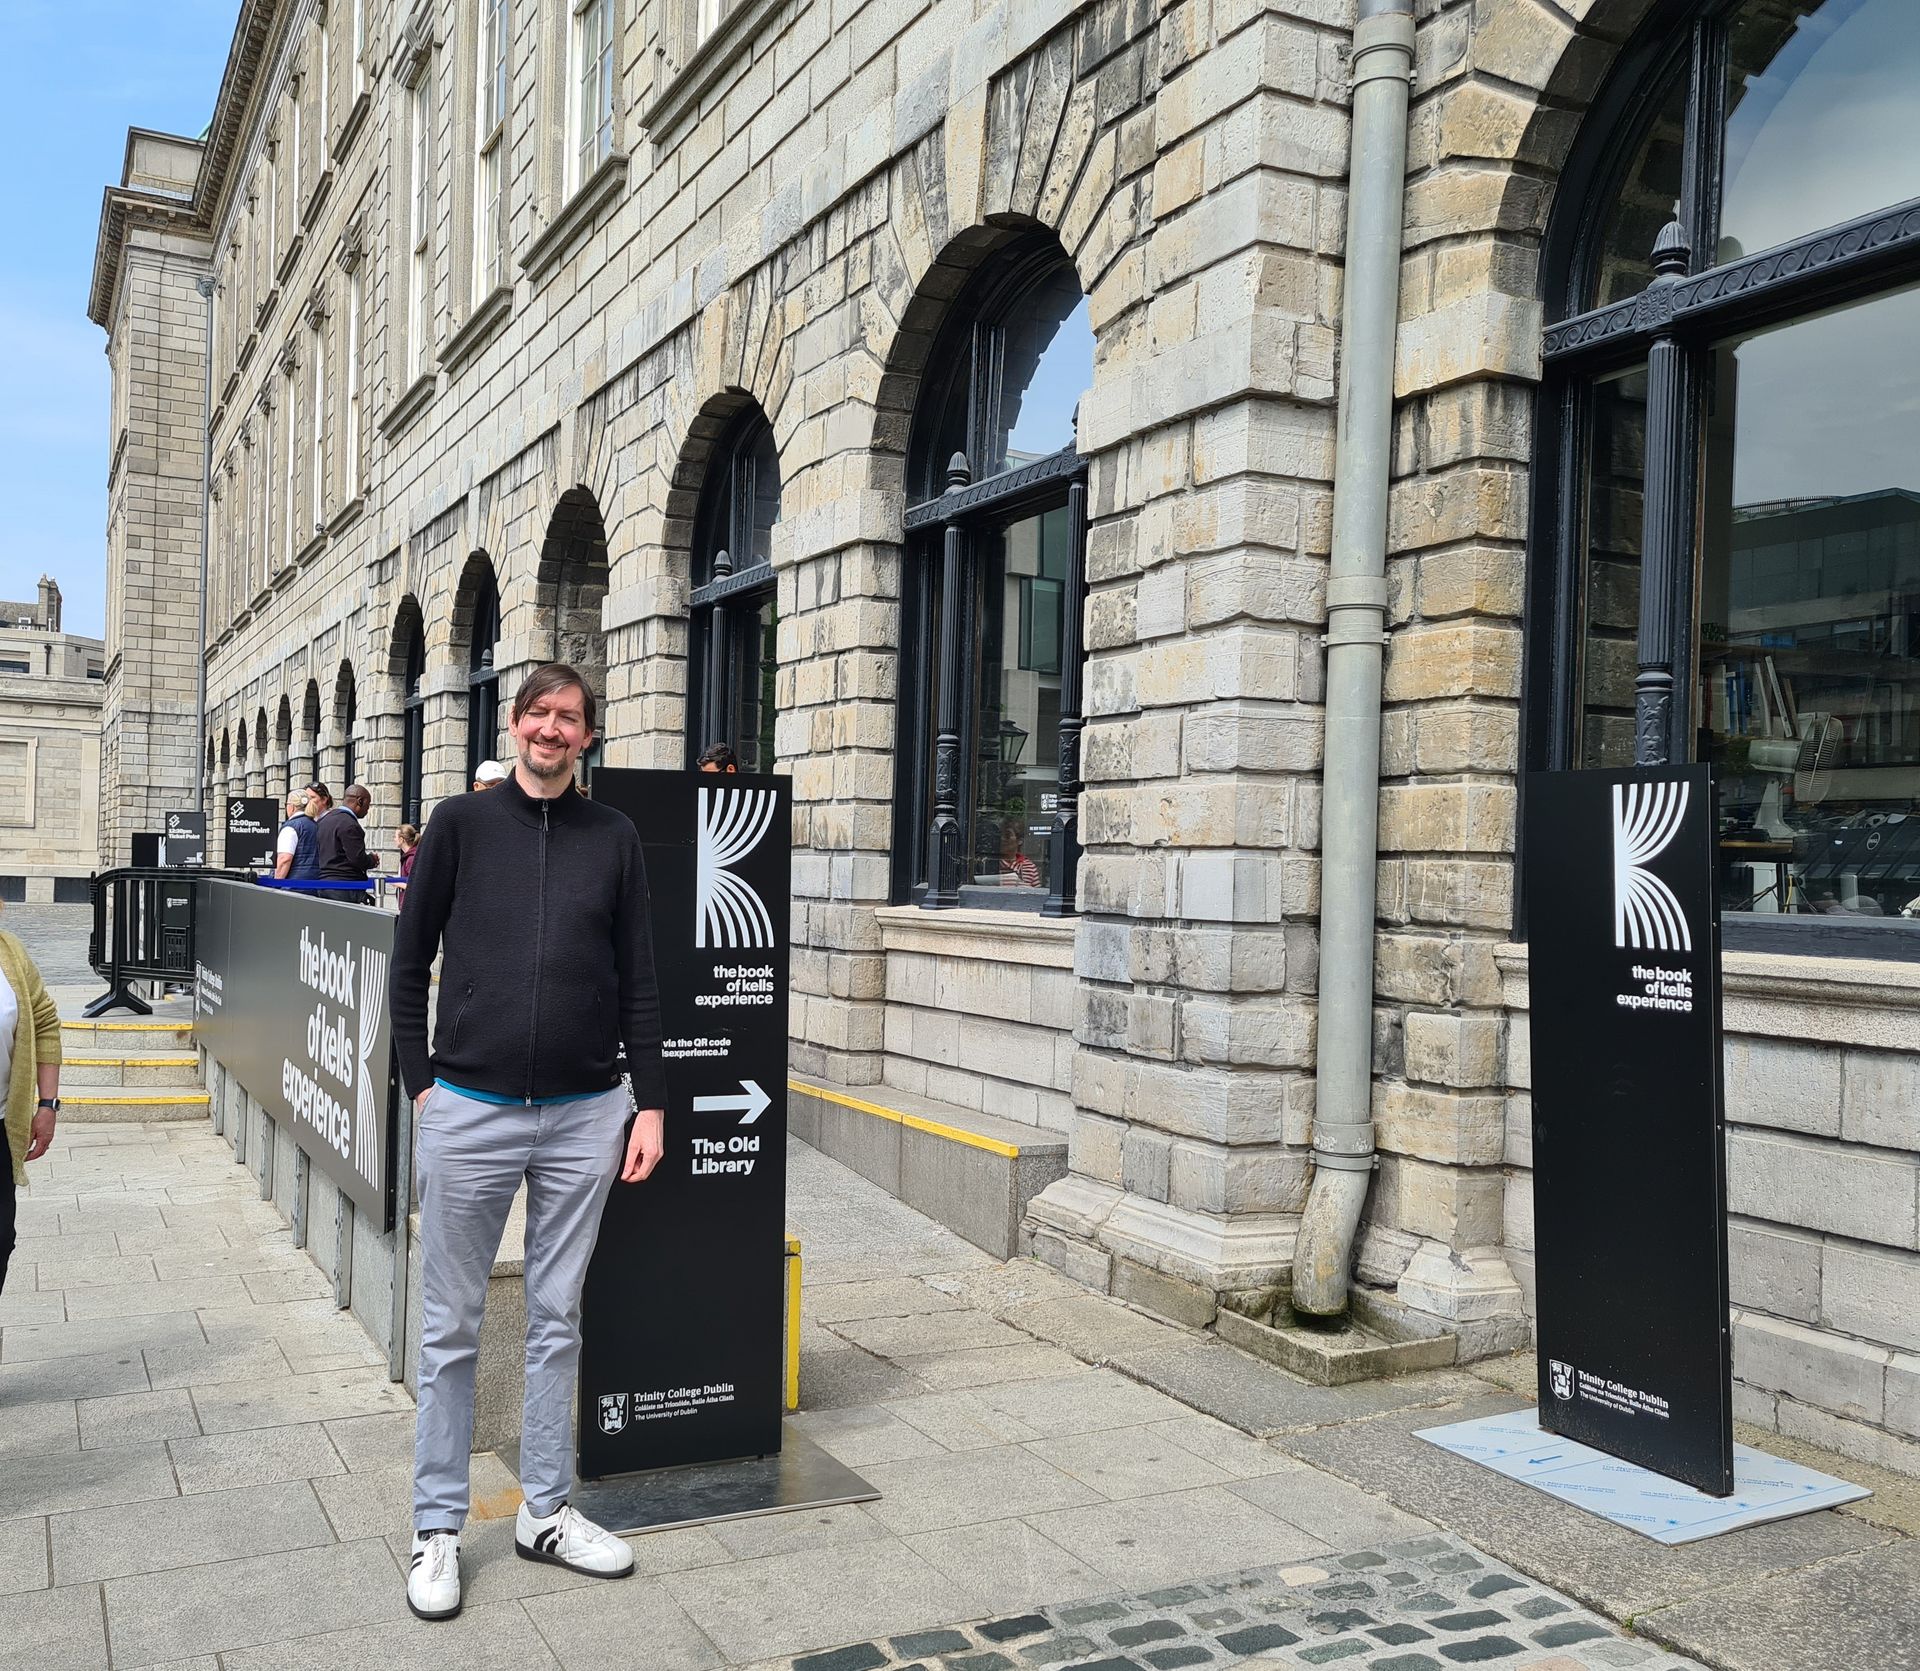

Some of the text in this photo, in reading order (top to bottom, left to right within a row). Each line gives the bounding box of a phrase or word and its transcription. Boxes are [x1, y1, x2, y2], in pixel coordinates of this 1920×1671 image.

[300, 926, 355, 1010] the book
[713, 965, 774, 978] the book
[1632, 965, 1692, 982] the book
[726, 979, 774, 992] of kells
[1645, 981, 1692, 998] of kells
[695, 993, 773, 1008] experience
[1616, 994, 1692, 1012] experience
[307, 1003, 353, 1088] of kells
[663, 1037, 732, 1047] via the QR code
[282, 1057, 351, 1159] experience
[692, 1136, 760, 1155] The Old
[692, 1157, 755, 1175] Library
[634, 1383, 734, 1402] Trinity College Dublin
[1578, 1370, 1669, 1409] Trinity College Dublin
[646, 1411, 673, 1420] University
[680, 1408, 698, 1416] Dublin
